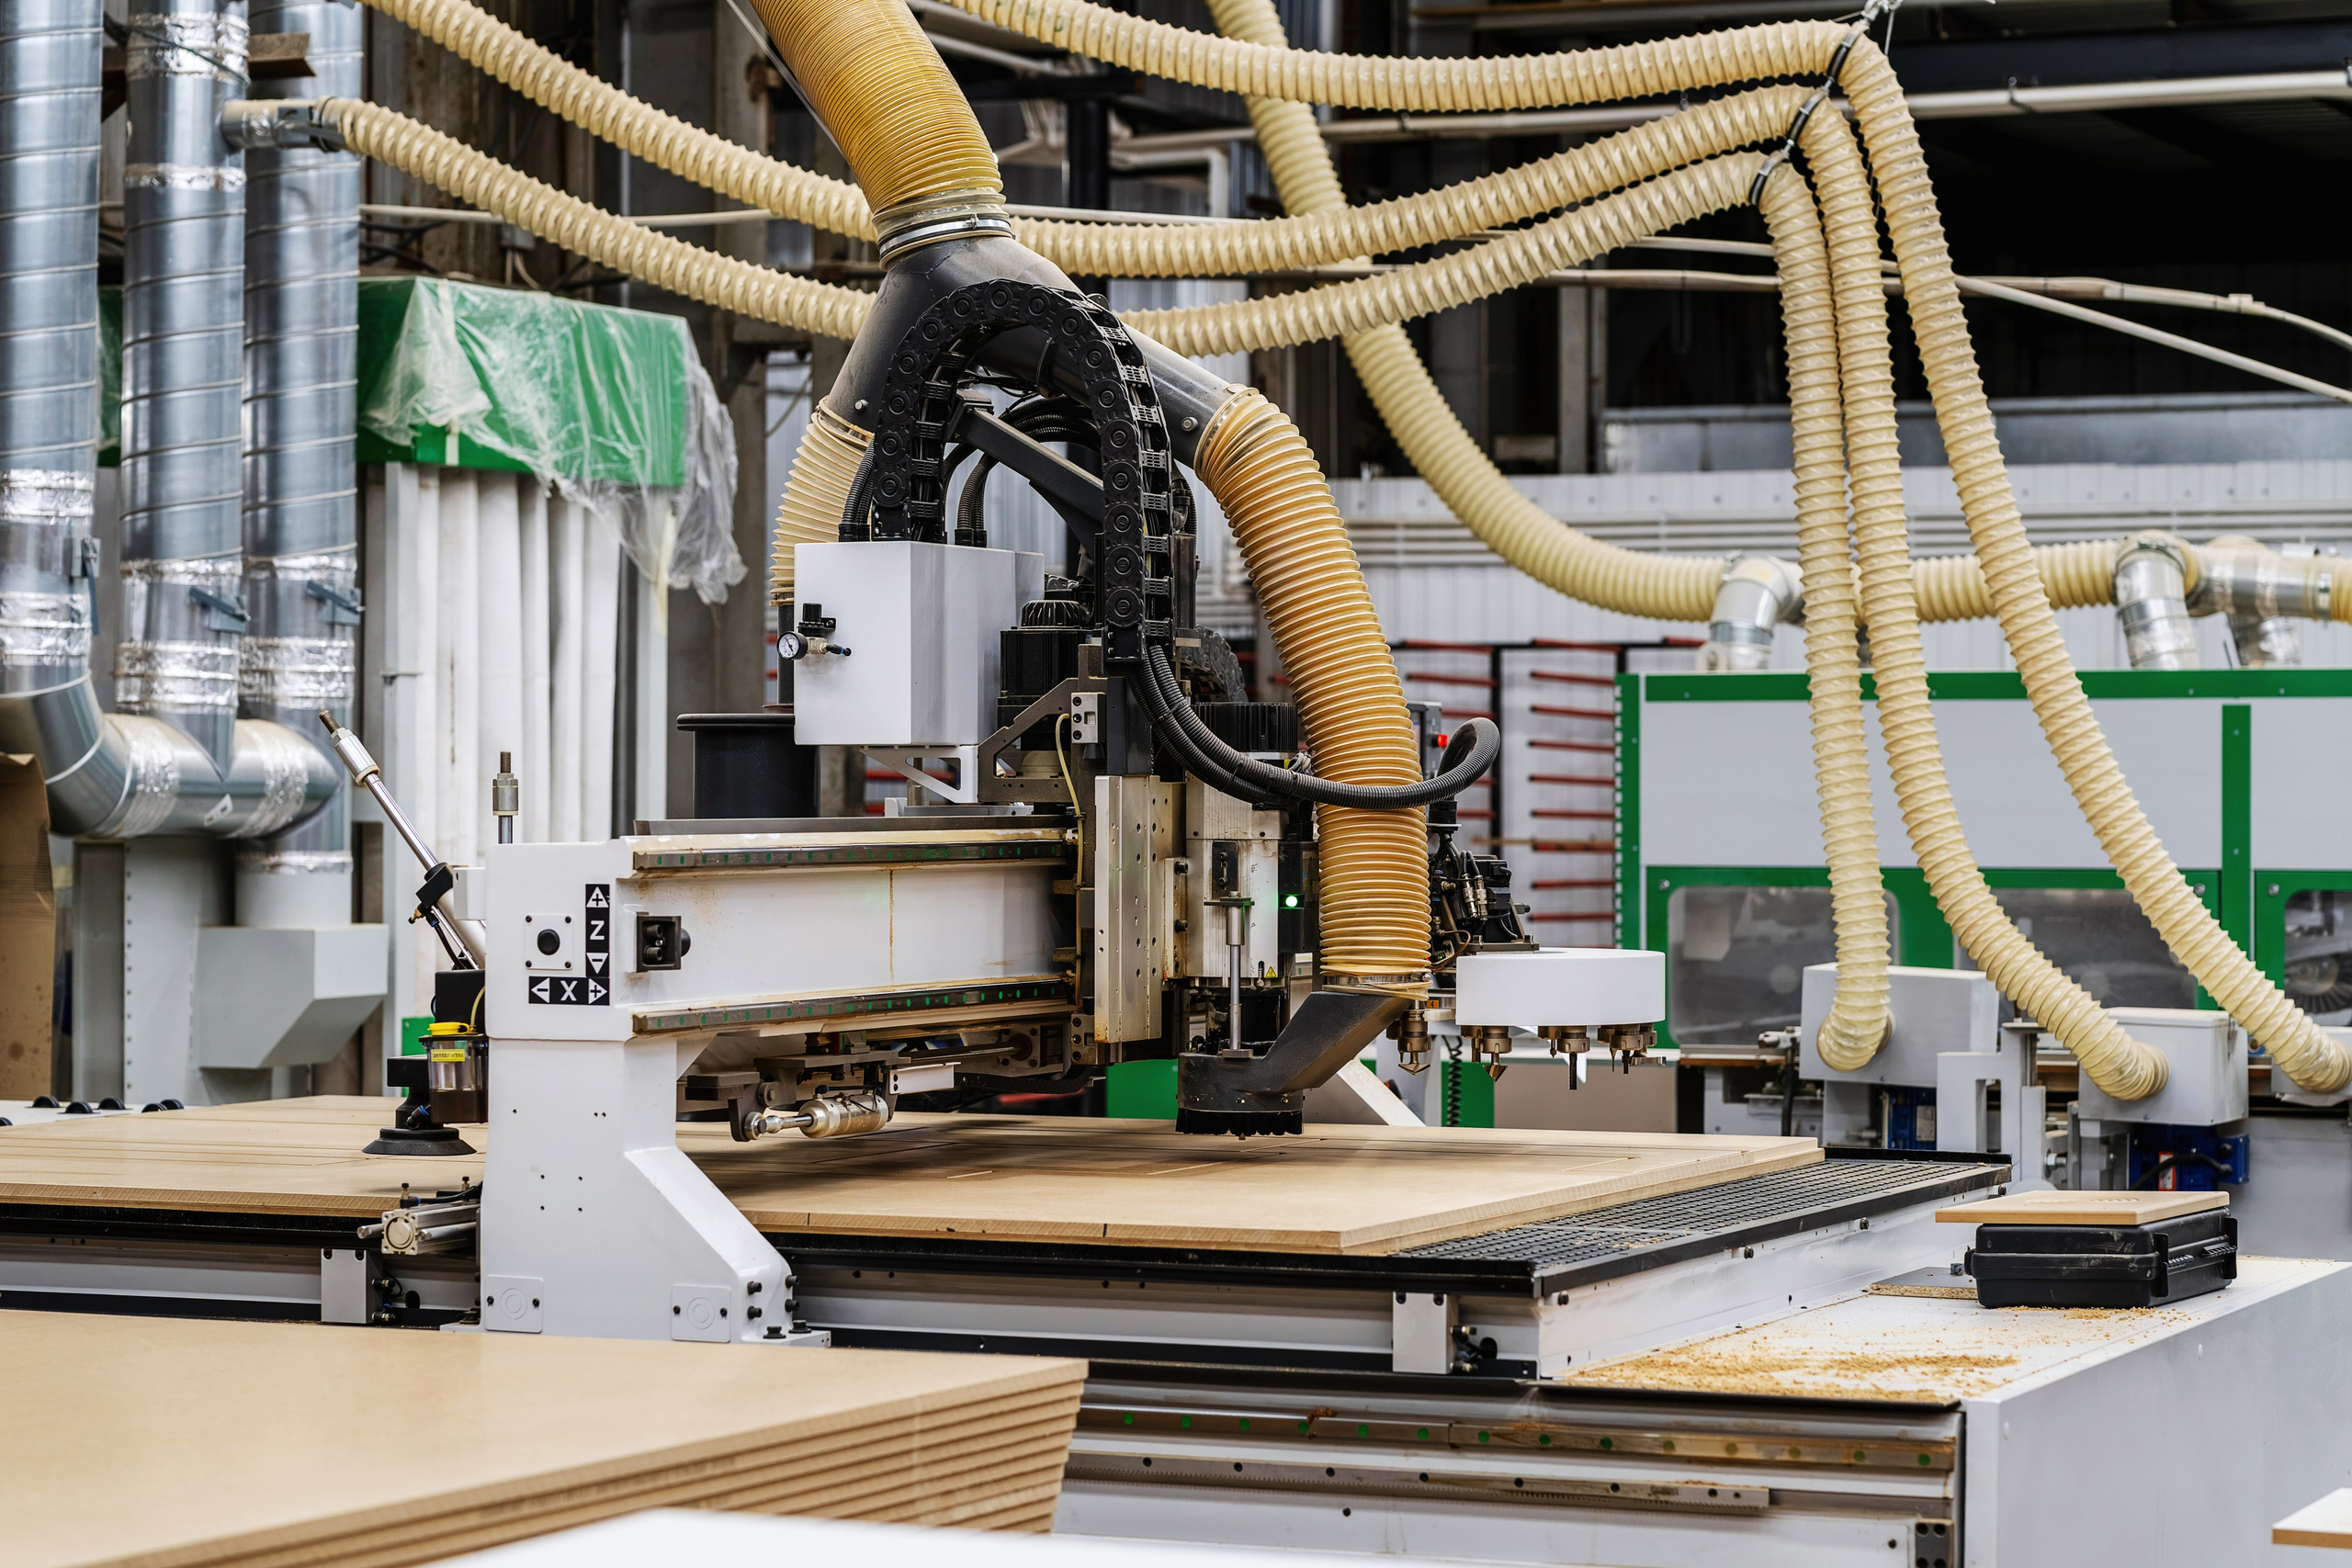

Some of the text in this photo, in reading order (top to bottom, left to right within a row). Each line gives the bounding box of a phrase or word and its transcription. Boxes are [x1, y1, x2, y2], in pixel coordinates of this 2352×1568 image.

[590, 919, 605, 941] Z
[560, 980, 578, 1001] X
[1430, 1000, 1435, 1009] 4
